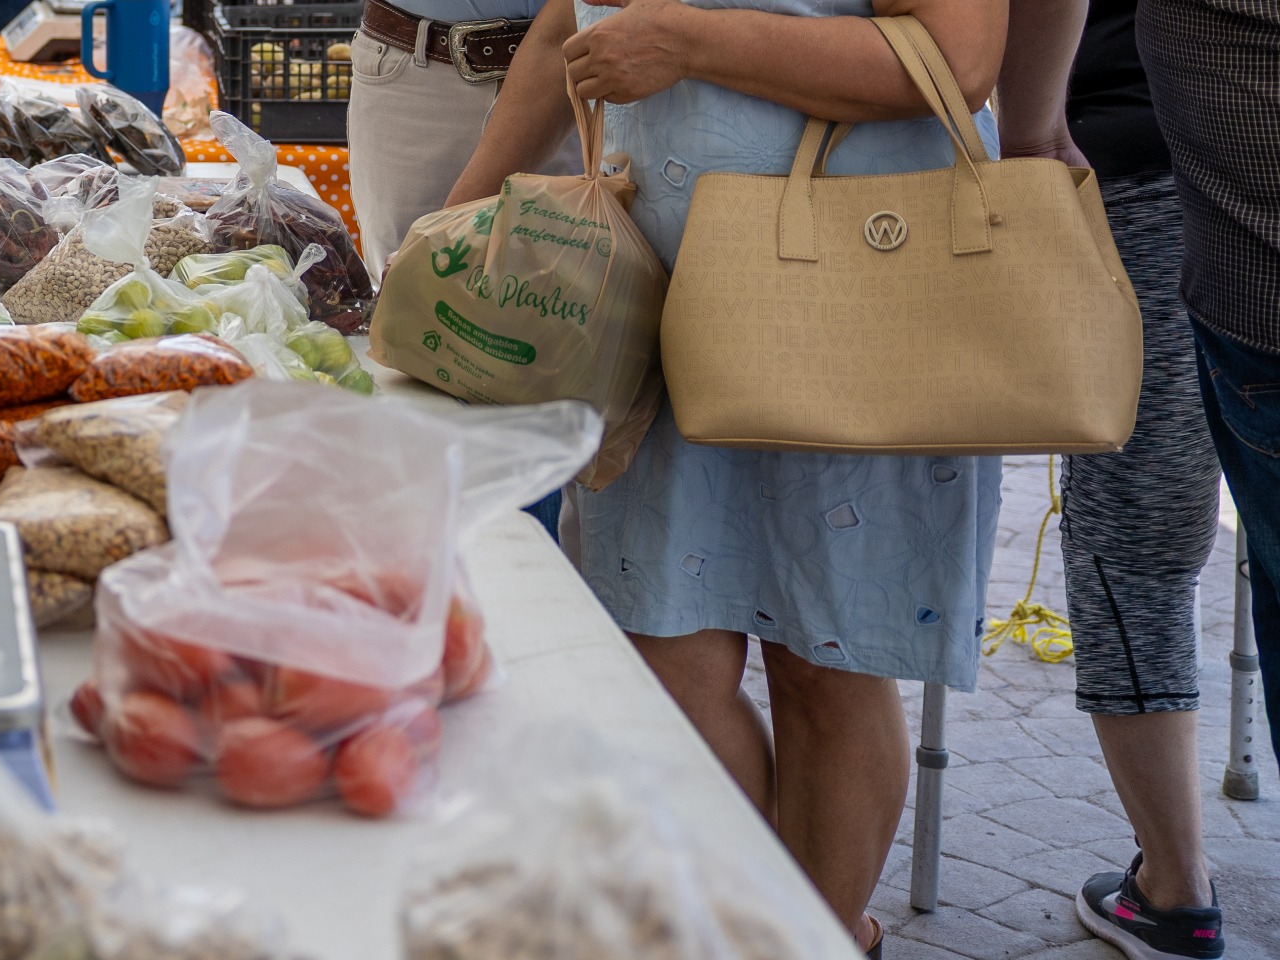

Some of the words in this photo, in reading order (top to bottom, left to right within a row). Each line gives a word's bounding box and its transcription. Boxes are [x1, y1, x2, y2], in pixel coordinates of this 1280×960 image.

[519, 199, 576, 225] Gracias
[509, 224, 591, 251] preferencia
[465, 264, 494, 300] Ok
[498, 274, 594, 326] Plastics
[437, 313, 451, 328] con
[459, 331, 483, 349] medio
[484, 346, 528, 365] ambiente
[447, 309, 472, 333] Bolsas
[472, 329, 519, 352] amigables
[1193, 928, 1217, 939] NIKE
